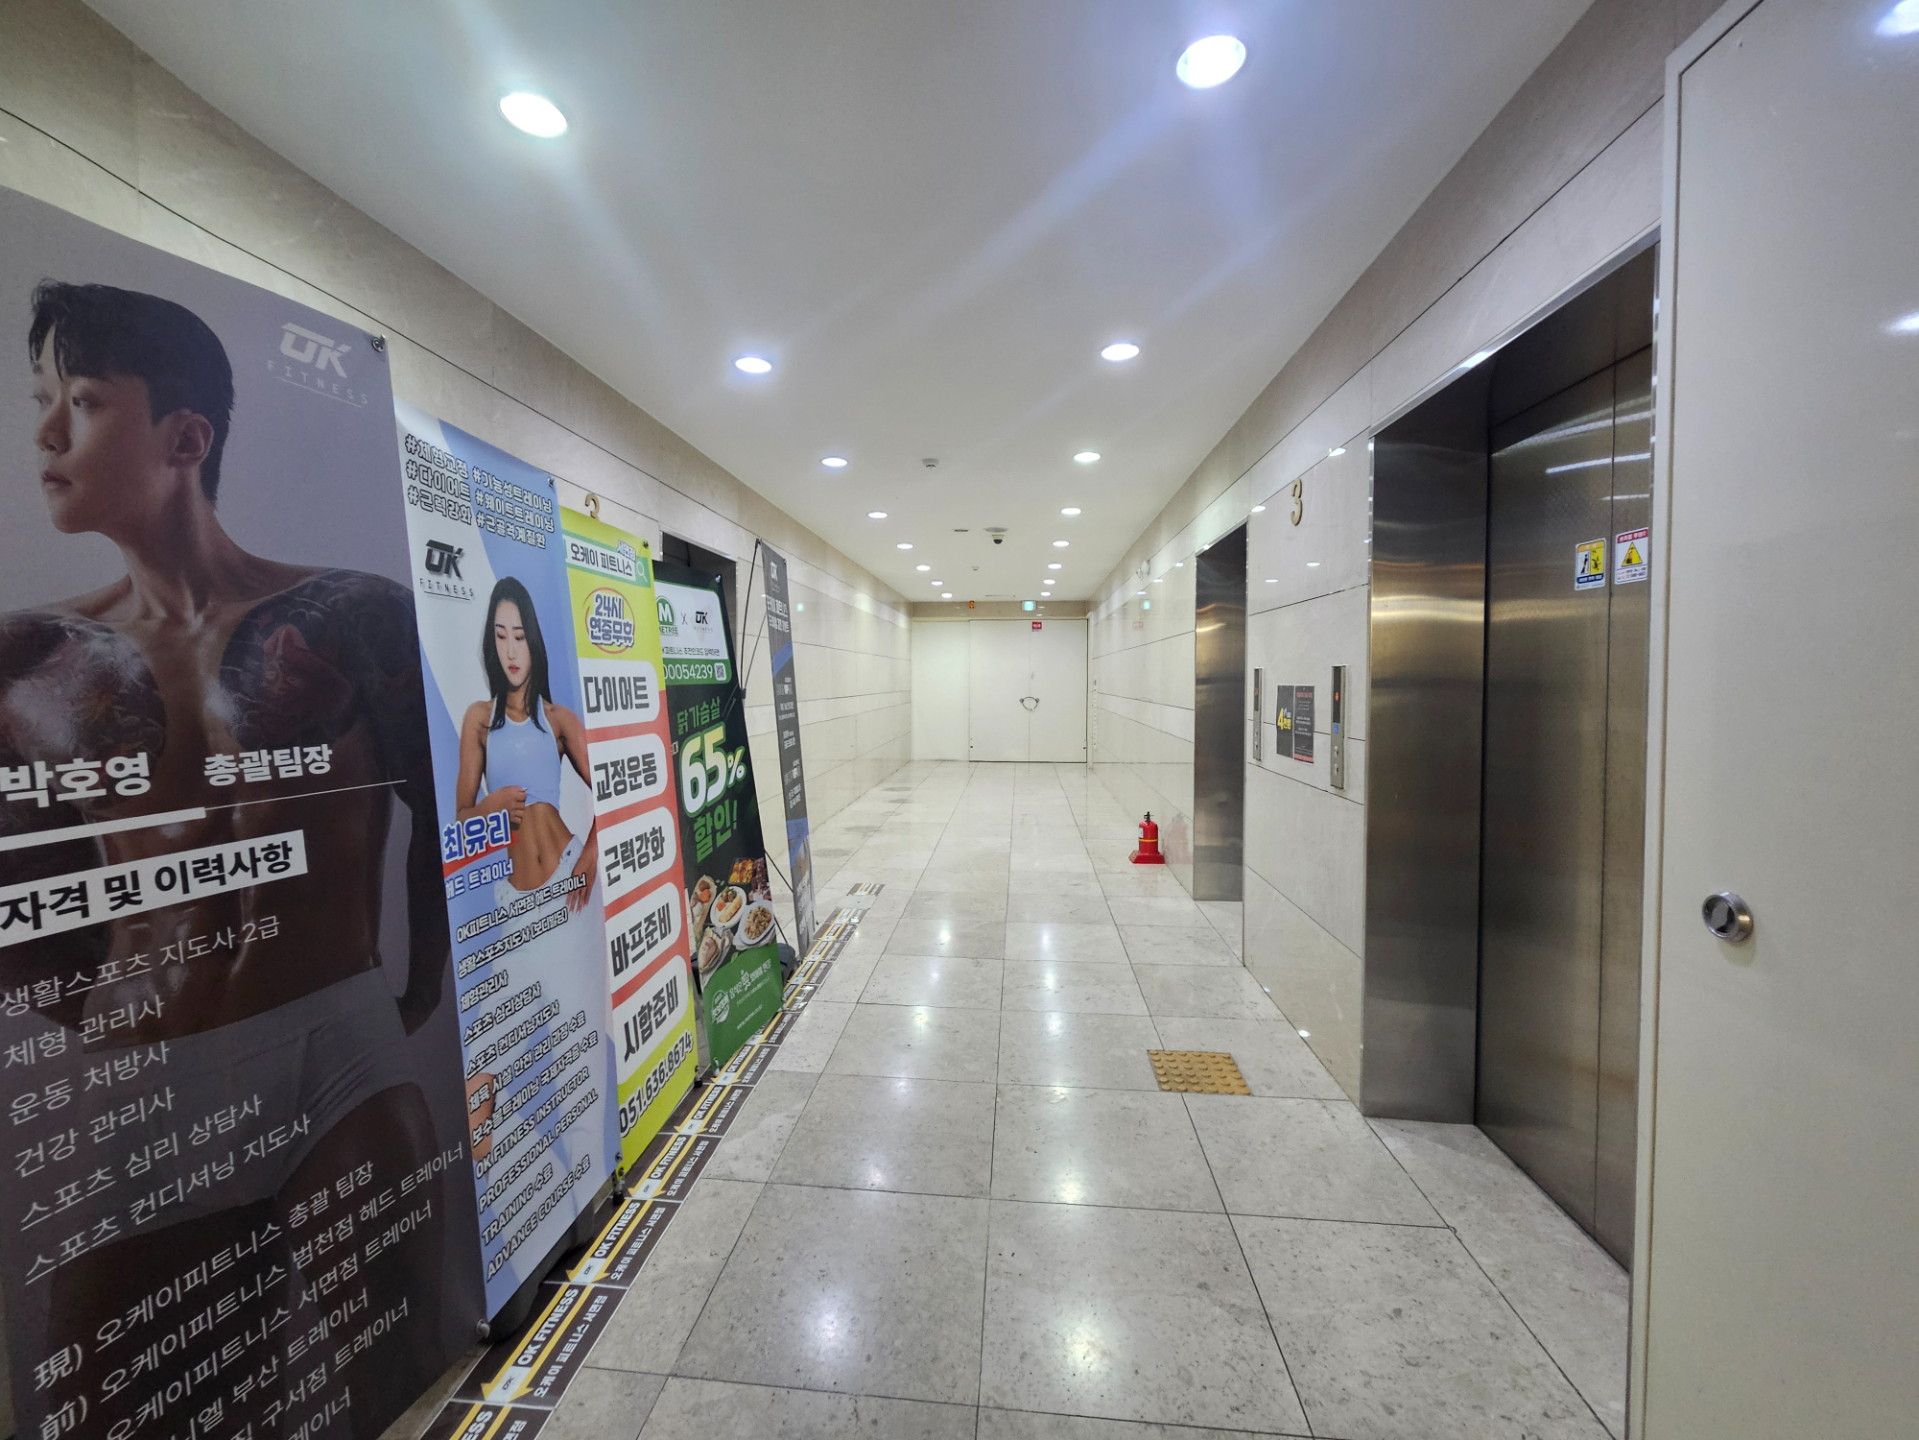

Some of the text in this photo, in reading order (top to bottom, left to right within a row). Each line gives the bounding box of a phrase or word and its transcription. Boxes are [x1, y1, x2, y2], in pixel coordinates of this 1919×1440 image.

[267, 359, 368, 404] FITNESS
[406, 459, 555, 533] #다이어트 #웨이트트레이닝
[408, 485, 472, 525] #근력강화
[472, 466, 553, 514] #기능성트레이닝
[1290, 478, 1303, 526] 3
[419, 577, 474, 597] FITNESS
[570, 543, 633, 577] 오케이 피트니스
[589, 616, 635, 646] 연중무휴
[594, 593, 625, 620] 24시
[583, 676, 650, 714] 다이어트
[677, 696, 720, 735] 닭가슴살
[0, 743, 333, 808] 박호영 총괄팀장
[594, 752, 658, 802] 교정운동
[680, 724, 746, 816] 65%
[443, 810, 511, 863] 최유리
[468, 857, 514, 890] 트레이너
[604, 825, 665, 887] 근력강화
[0, 840, 293, 933] 자격 및 이력사항
[456, 907, 509, 943] OK피트니스
[509, 896, 536, 919] 서면점
[552, 873, 587, 899] 트레이너
[0, 915, 281, 1017] 생활스포츠 지도사 2급
[611, 902, 672, 977] 바프준비
[461, 969, 509, 1013] 체형관리사
[464, 981, 541, 1047] 스포츠 심리상담사
[623, 975, 679, 1063] 시합준비
[3, 995, 165, 1069] 체형 관리사
[466, 1044, 497, 1080] 스포츠
[469, 1011, 586, 1114] 체육 시설 안전 관리 과정 수료
[580, 1030, 599, 1053] 수료
[8, 1040, 171, 1126] 운동 처방사
[620, 1030, 693, 1136] 051.636.8674
[13, 1086, 175, 1178] 건강 관리사
[475, 1065, 591, 1180] OK FITNESS INSTRUCTOR
[479, 1088, 599, 1215] PROFESSIONAL PERSONAL
[650, 1136, 687, 1179] OK FITNESS
[20, 1094, 262, 1232] 스포츠 심리 상담사
[25, 1113, 312, 1286] 스포츠 컨디셔닝 지도사
[482, 1162, 554, 1246] TRAINING 수료
[487, 1154, 591, 1284] ADVANCE COURSE 수료
[593, 1202, 640, 1257] OK FITNESS
[95, 1220, 283, 1353] 오케이피트니스
[288, 1186, 331, 1230] 총괄
[336, 1160, 375, 1199] 팀장
[100, 1262, 288, 1404] 오케이피트니스
[292, 1220, 356, 1270] 범천점
[358, 1189, 396, 1224] 헤드
[400, 1141, 465, 1198] 트레이너
[610, 1206, 665, 1281] 오케이 피트니스 서면점
[105, 1199, 433, 1440] 오케이피트니스 서면점 트레이너
[232, 1355, 280, 1404] 부산
[287, 1287, 369, 1366] 트레이너
[517, 1288, 579, 1366] OK FITNESS
[534, 1295, 608, 1398] 오케이 피트니스 서면점
[261, 1297, 409, 1427] 구서점 트레이너
